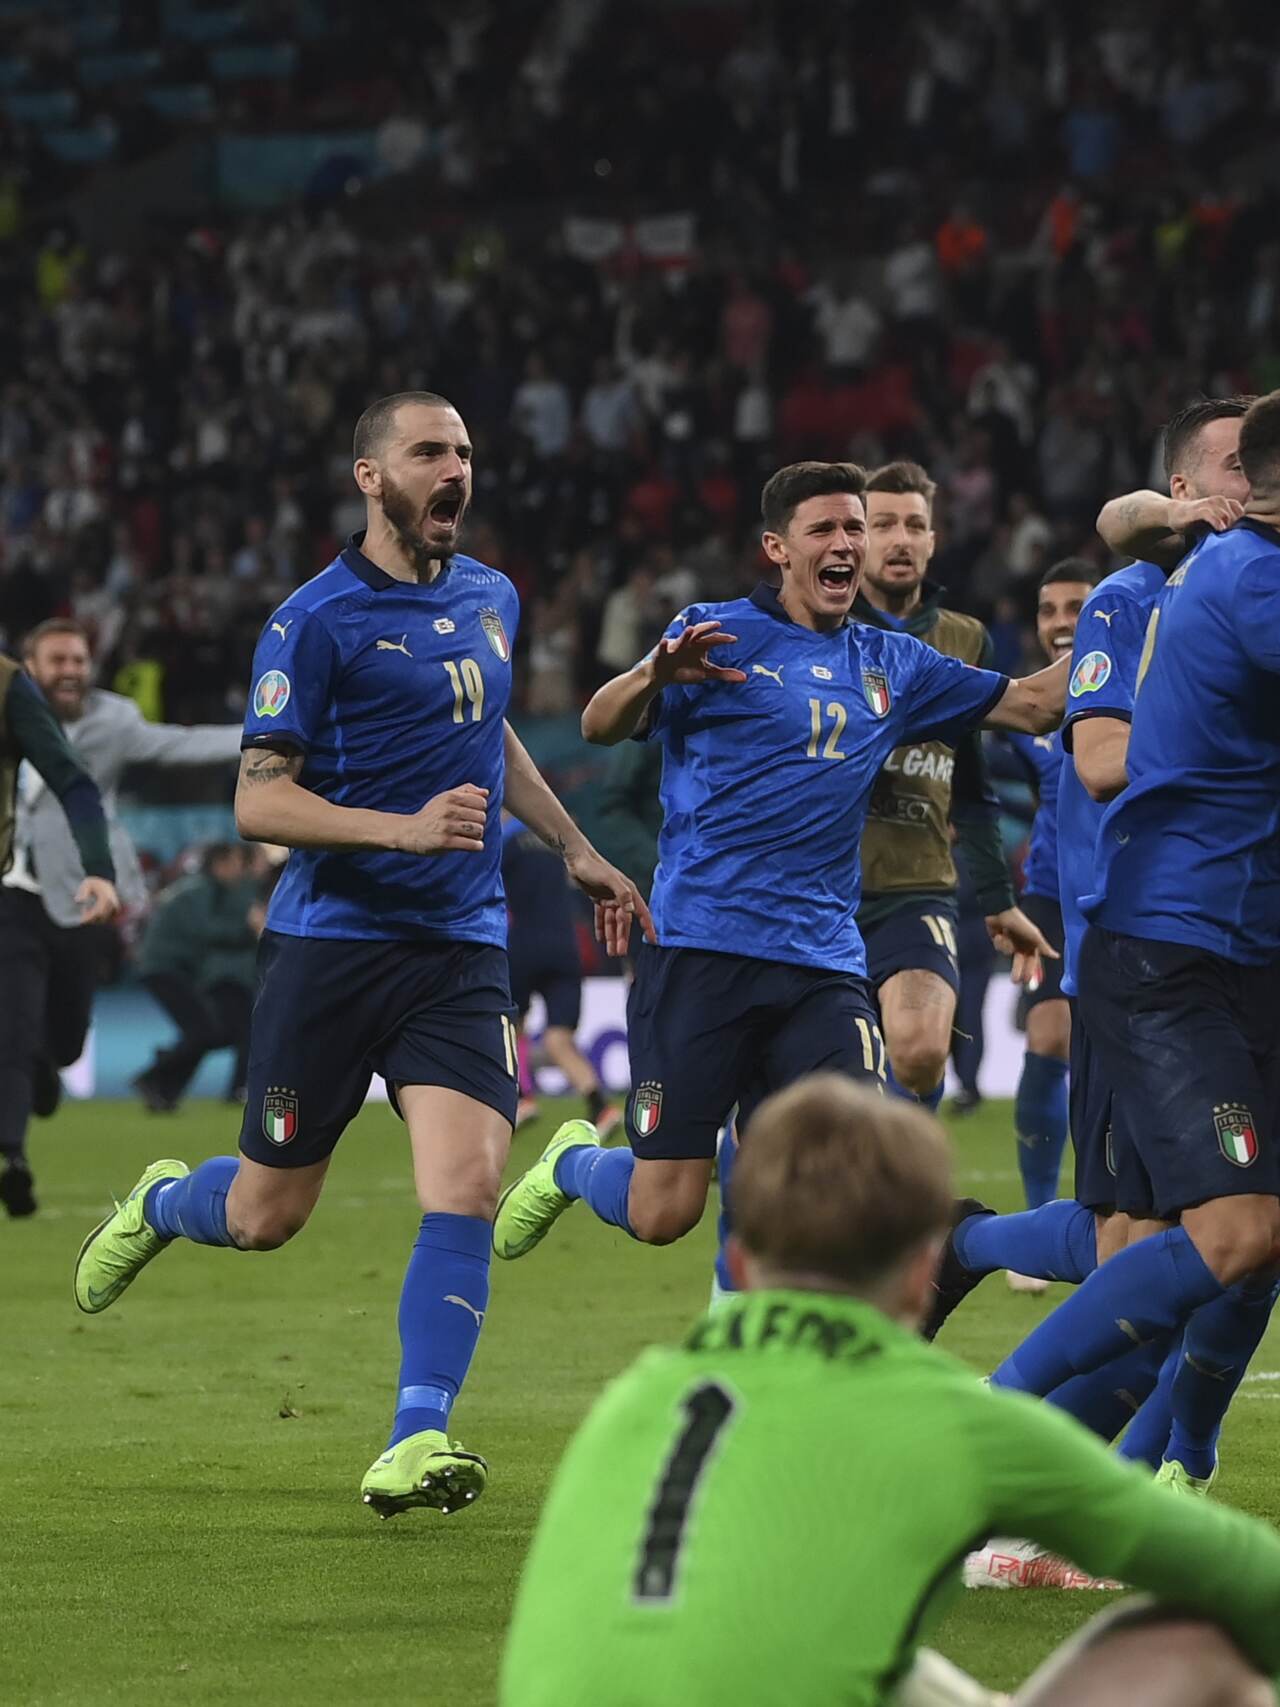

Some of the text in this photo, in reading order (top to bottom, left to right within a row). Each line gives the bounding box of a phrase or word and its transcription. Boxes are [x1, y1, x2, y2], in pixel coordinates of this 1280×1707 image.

[442, 658, 485, 724] 19
[807, 698, 848, 760] 12
[634, 1379, 737, 1602] 1
